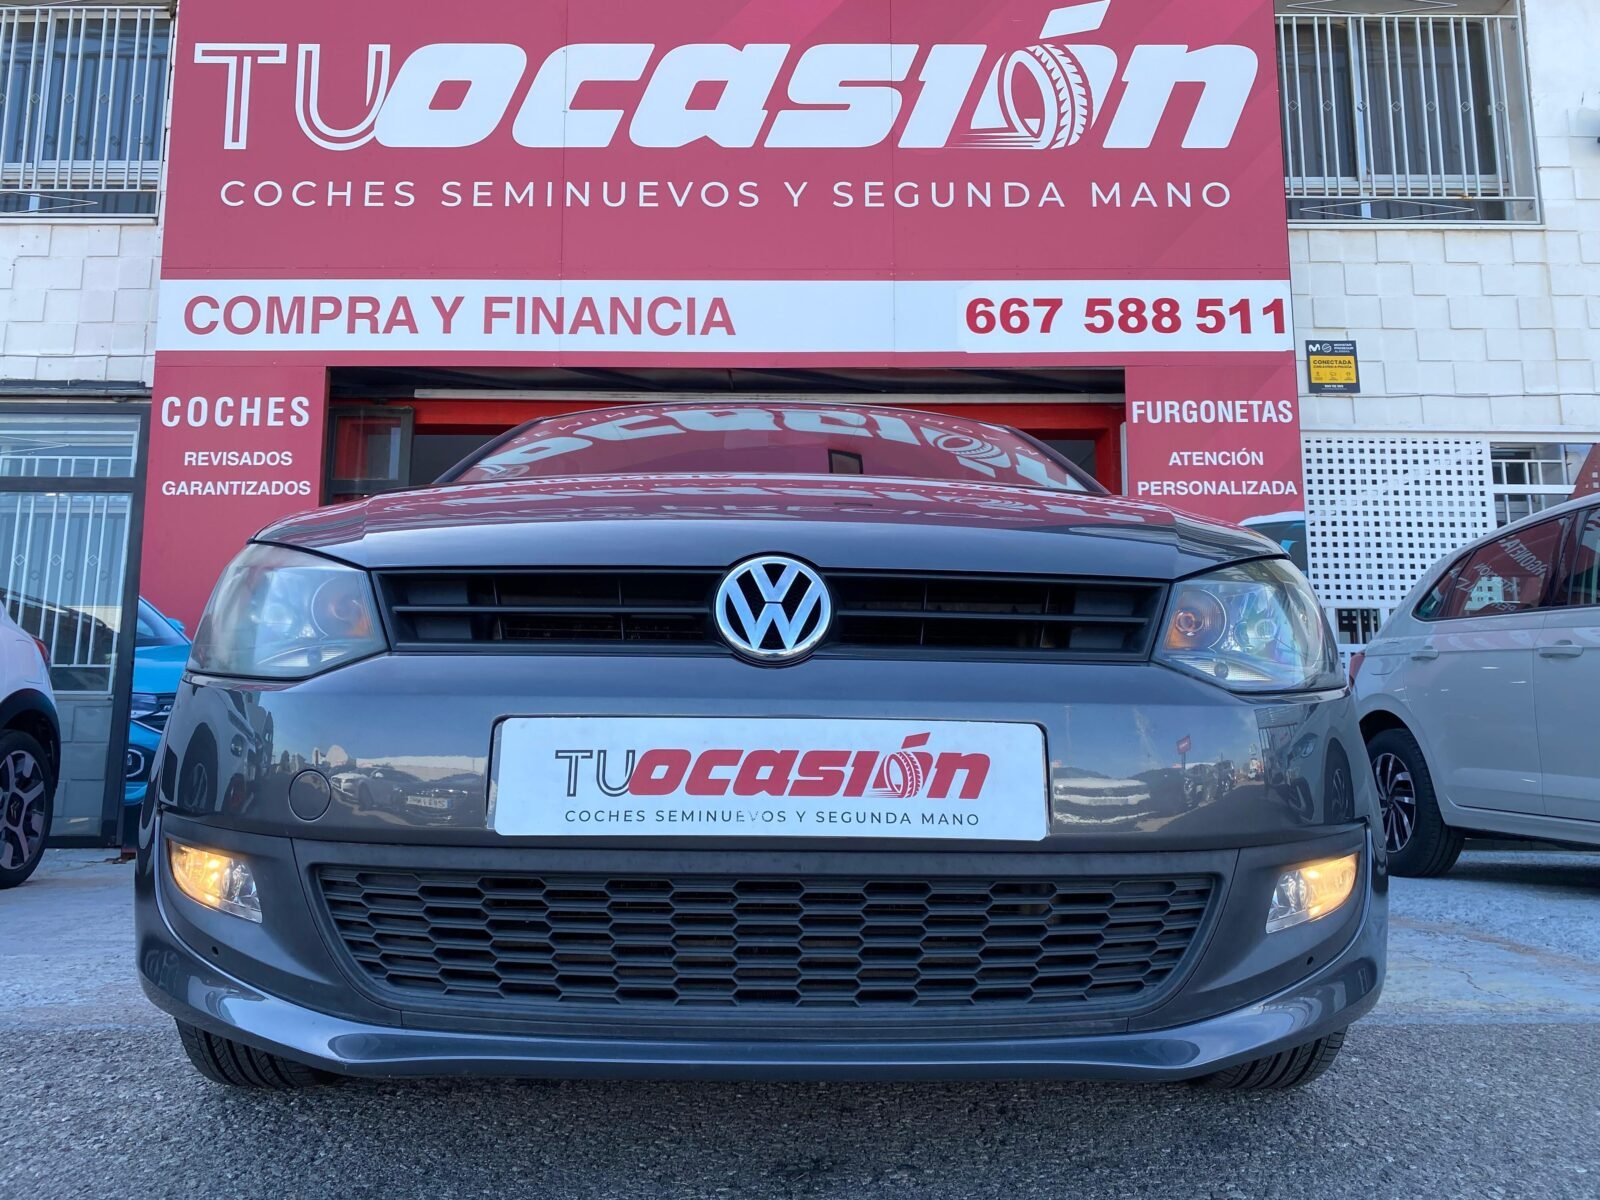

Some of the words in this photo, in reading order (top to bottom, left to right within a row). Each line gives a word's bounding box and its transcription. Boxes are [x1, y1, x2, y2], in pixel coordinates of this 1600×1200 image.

[220, 180, 415, 207] COCHES
[441, 181, 759, 208] SEMINUEVOS
[783, 181, 808, 207] Y
[832, 181, 1065, 208] SEGUNDA
[1091, 181, 1231, 208] MANO
[183, 295, 419, 336] COMPRA
[431, 295, 465, 334] Y
[483, 295, 737, 336] FINANCIA
[965, 297, 1063, 334] 667
[1084, 297, 1182, 334] 588
[1196, 298, 1285, 334] 511
[161, 396, 310, 428] COCHES
[1131, 399, 1294, 424] FURGONETAS
[184, 450, 293, 466] REVISADOS
[1168, 447, 1264, 466] ATENCIÓN
[161, 480, 311, 496] GARANTIZADOS
[1137, 480, 1298, 496] PERSONALIZADA
[565, 810, 646, 823] COCHES
[655, 810, 787, 824] SEMINUEVOS
[796, 810, 807, 823] Y
[815, 811, 912, 825] SEGUNDA
[921, 812, 980, 826] MANO
